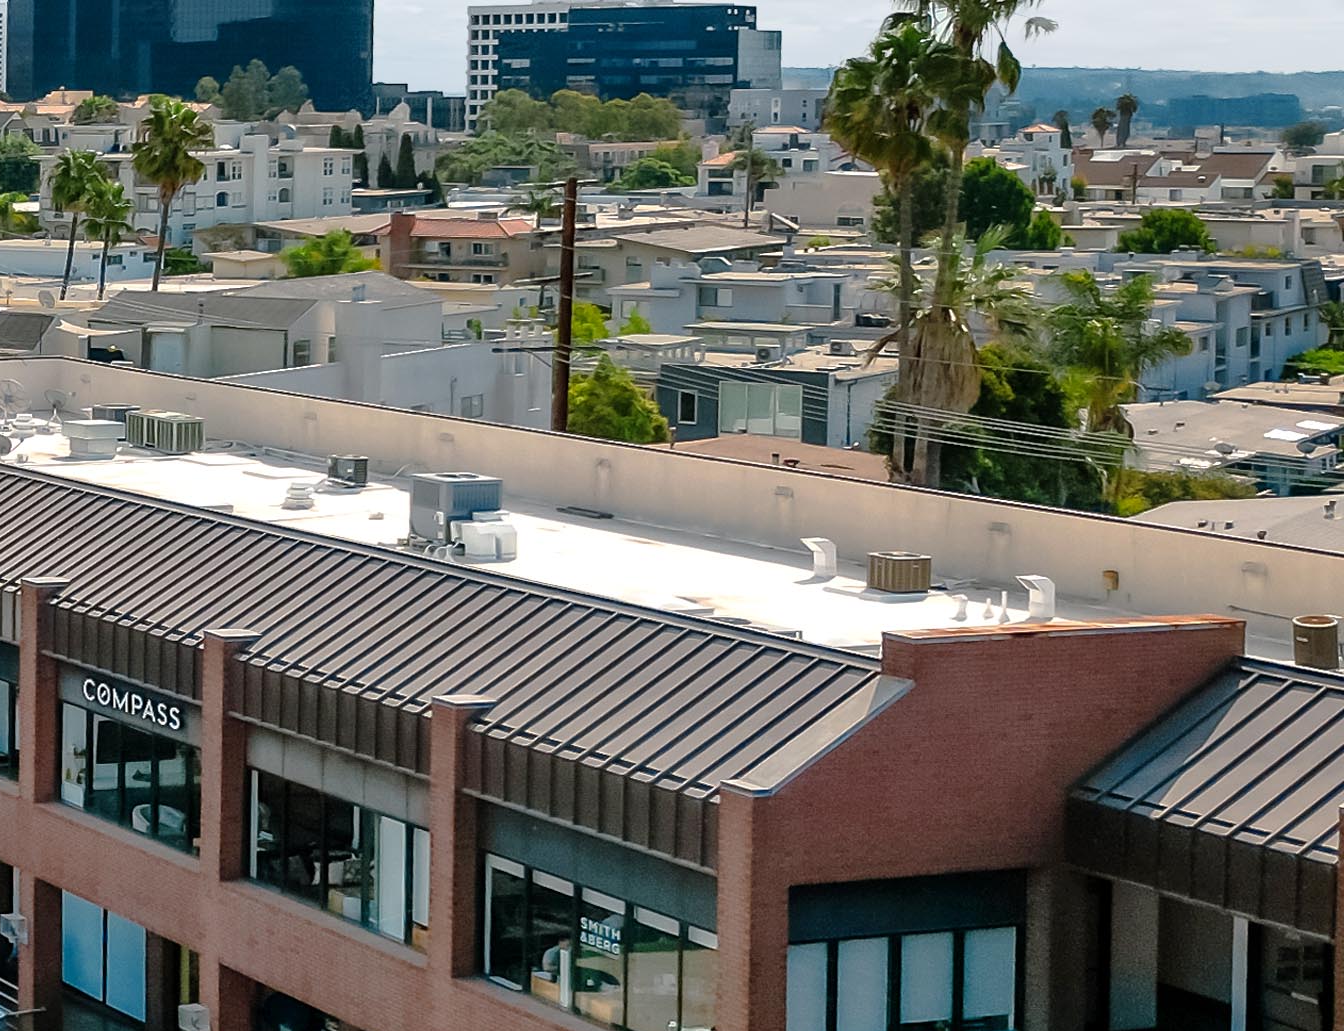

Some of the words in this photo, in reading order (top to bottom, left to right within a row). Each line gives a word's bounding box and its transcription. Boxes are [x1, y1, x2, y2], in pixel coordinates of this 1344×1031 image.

[83, 679, 180, 730] COMPASS
[580, 916, 621, 941] SMITH
[580, 931, 621, 954] &BERG
